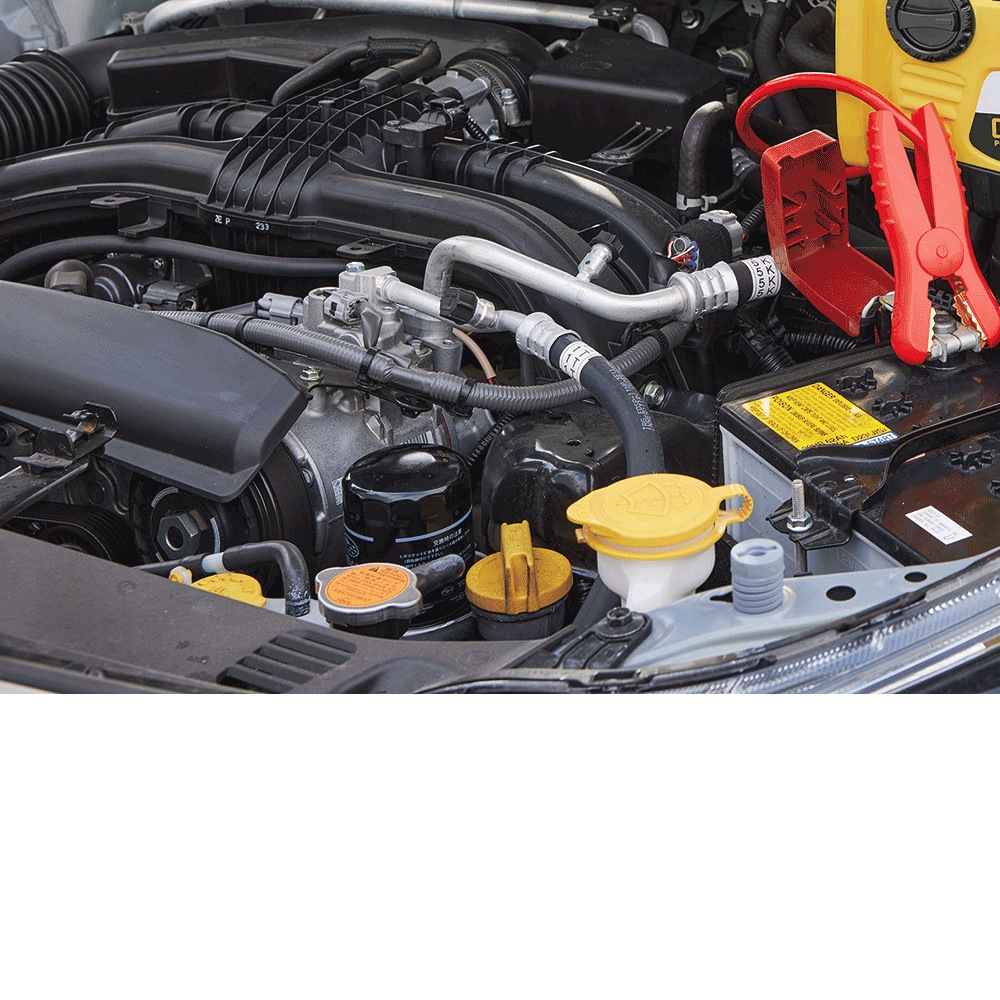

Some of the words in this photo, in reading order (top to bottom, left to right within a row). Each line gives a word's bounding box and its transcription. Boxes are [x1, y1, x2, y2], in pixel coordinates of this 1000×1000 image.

[255, 221, 270, 231] 233
[812, 383, 837, 399] DANGER
[772, 395, 793, 411] POISON
